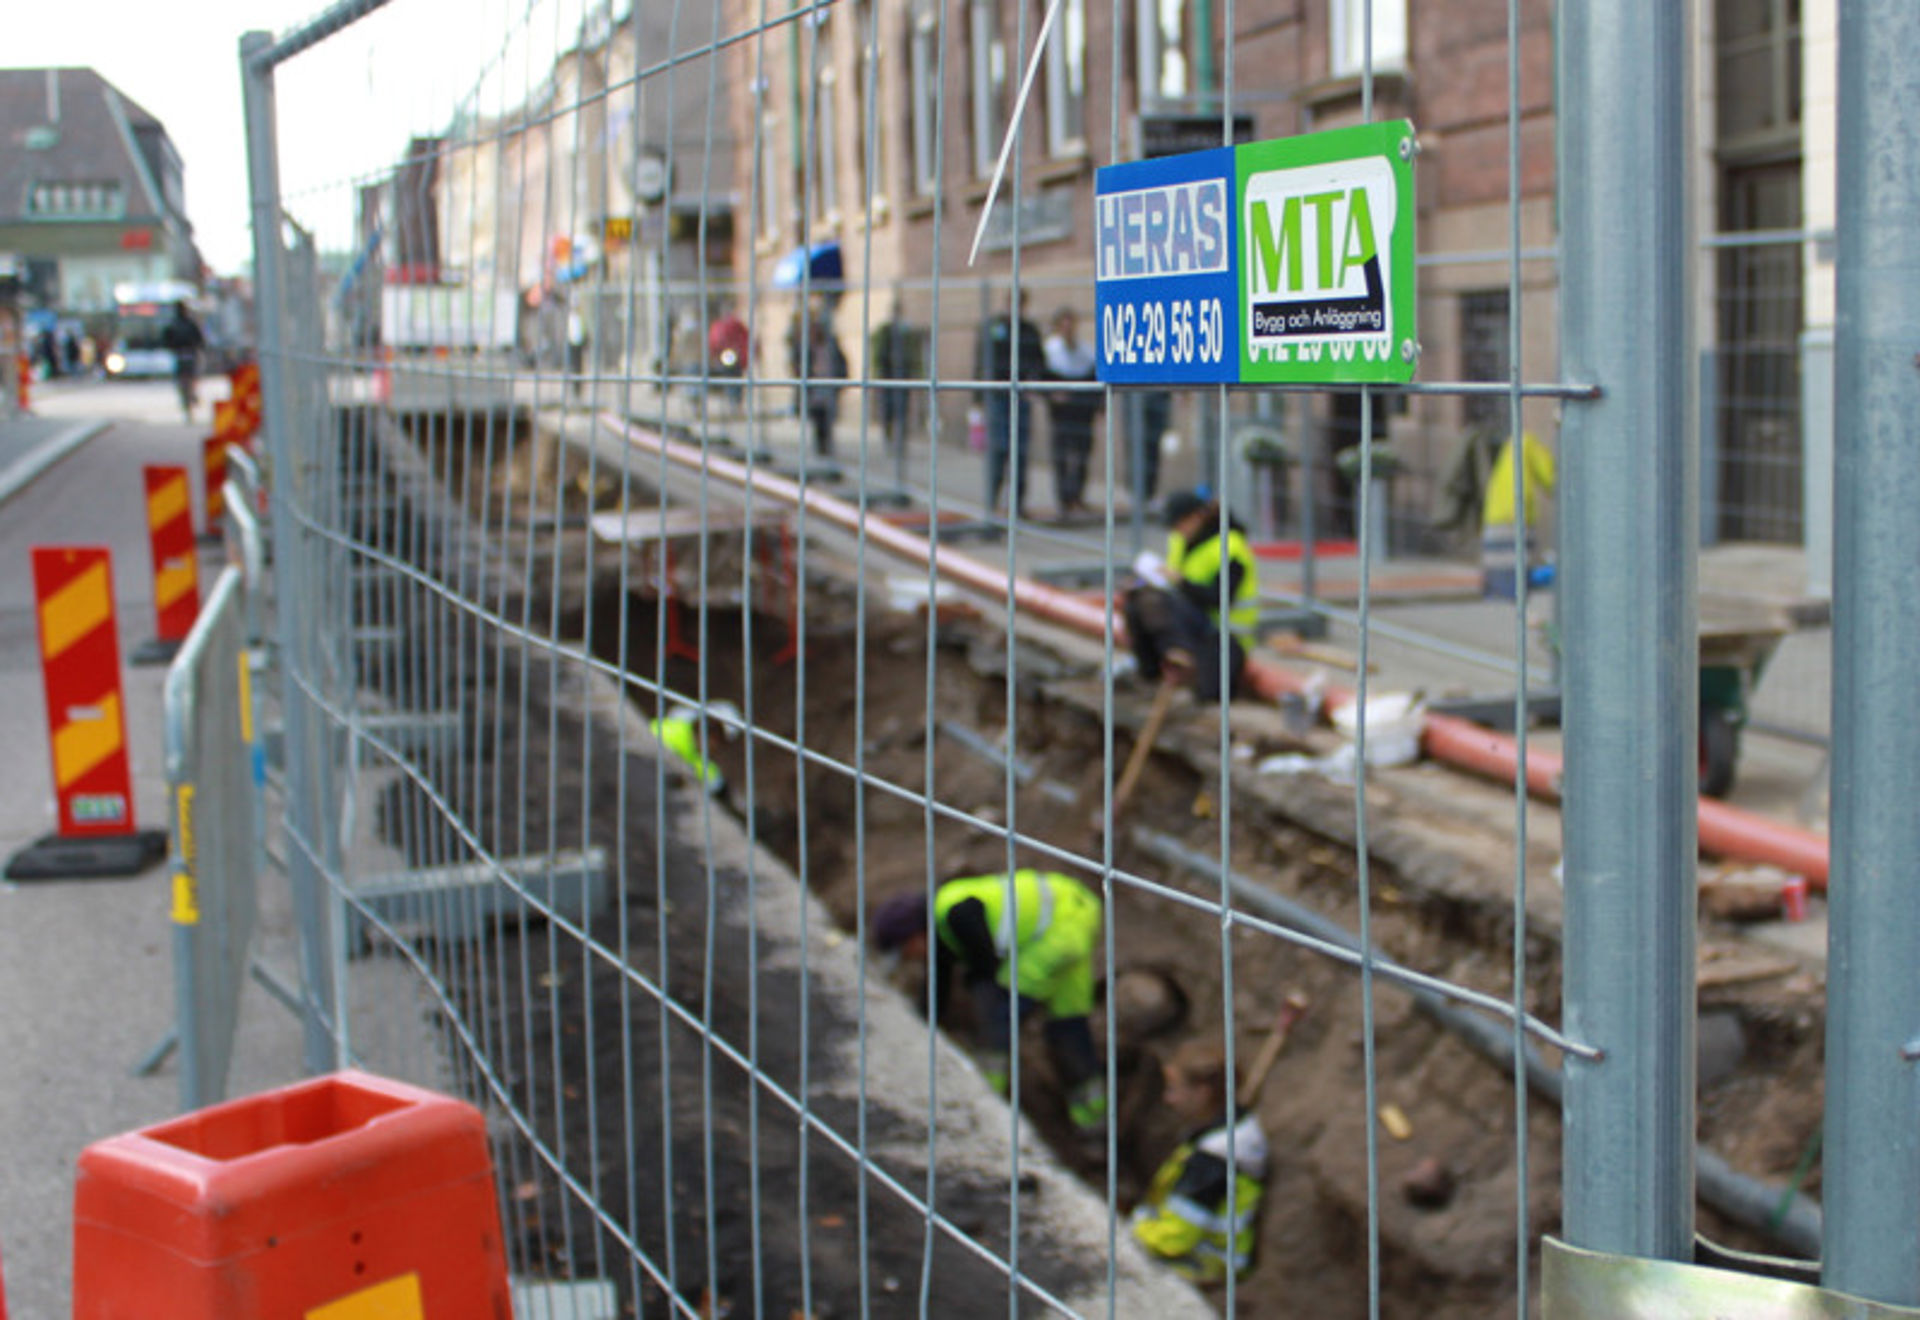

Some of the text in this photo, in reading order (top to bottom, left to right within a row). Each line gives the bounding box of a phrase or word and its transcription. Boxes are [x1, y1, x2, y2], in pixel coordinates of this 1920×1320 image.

[1100, 184, 1223, 278] HERAS
[1251, 186, 1384, 294] MTA
[1103, 297, 1223, 365] 042-29 56 50
[1255, 304, 1381, 333] Bygg och Anläggning
